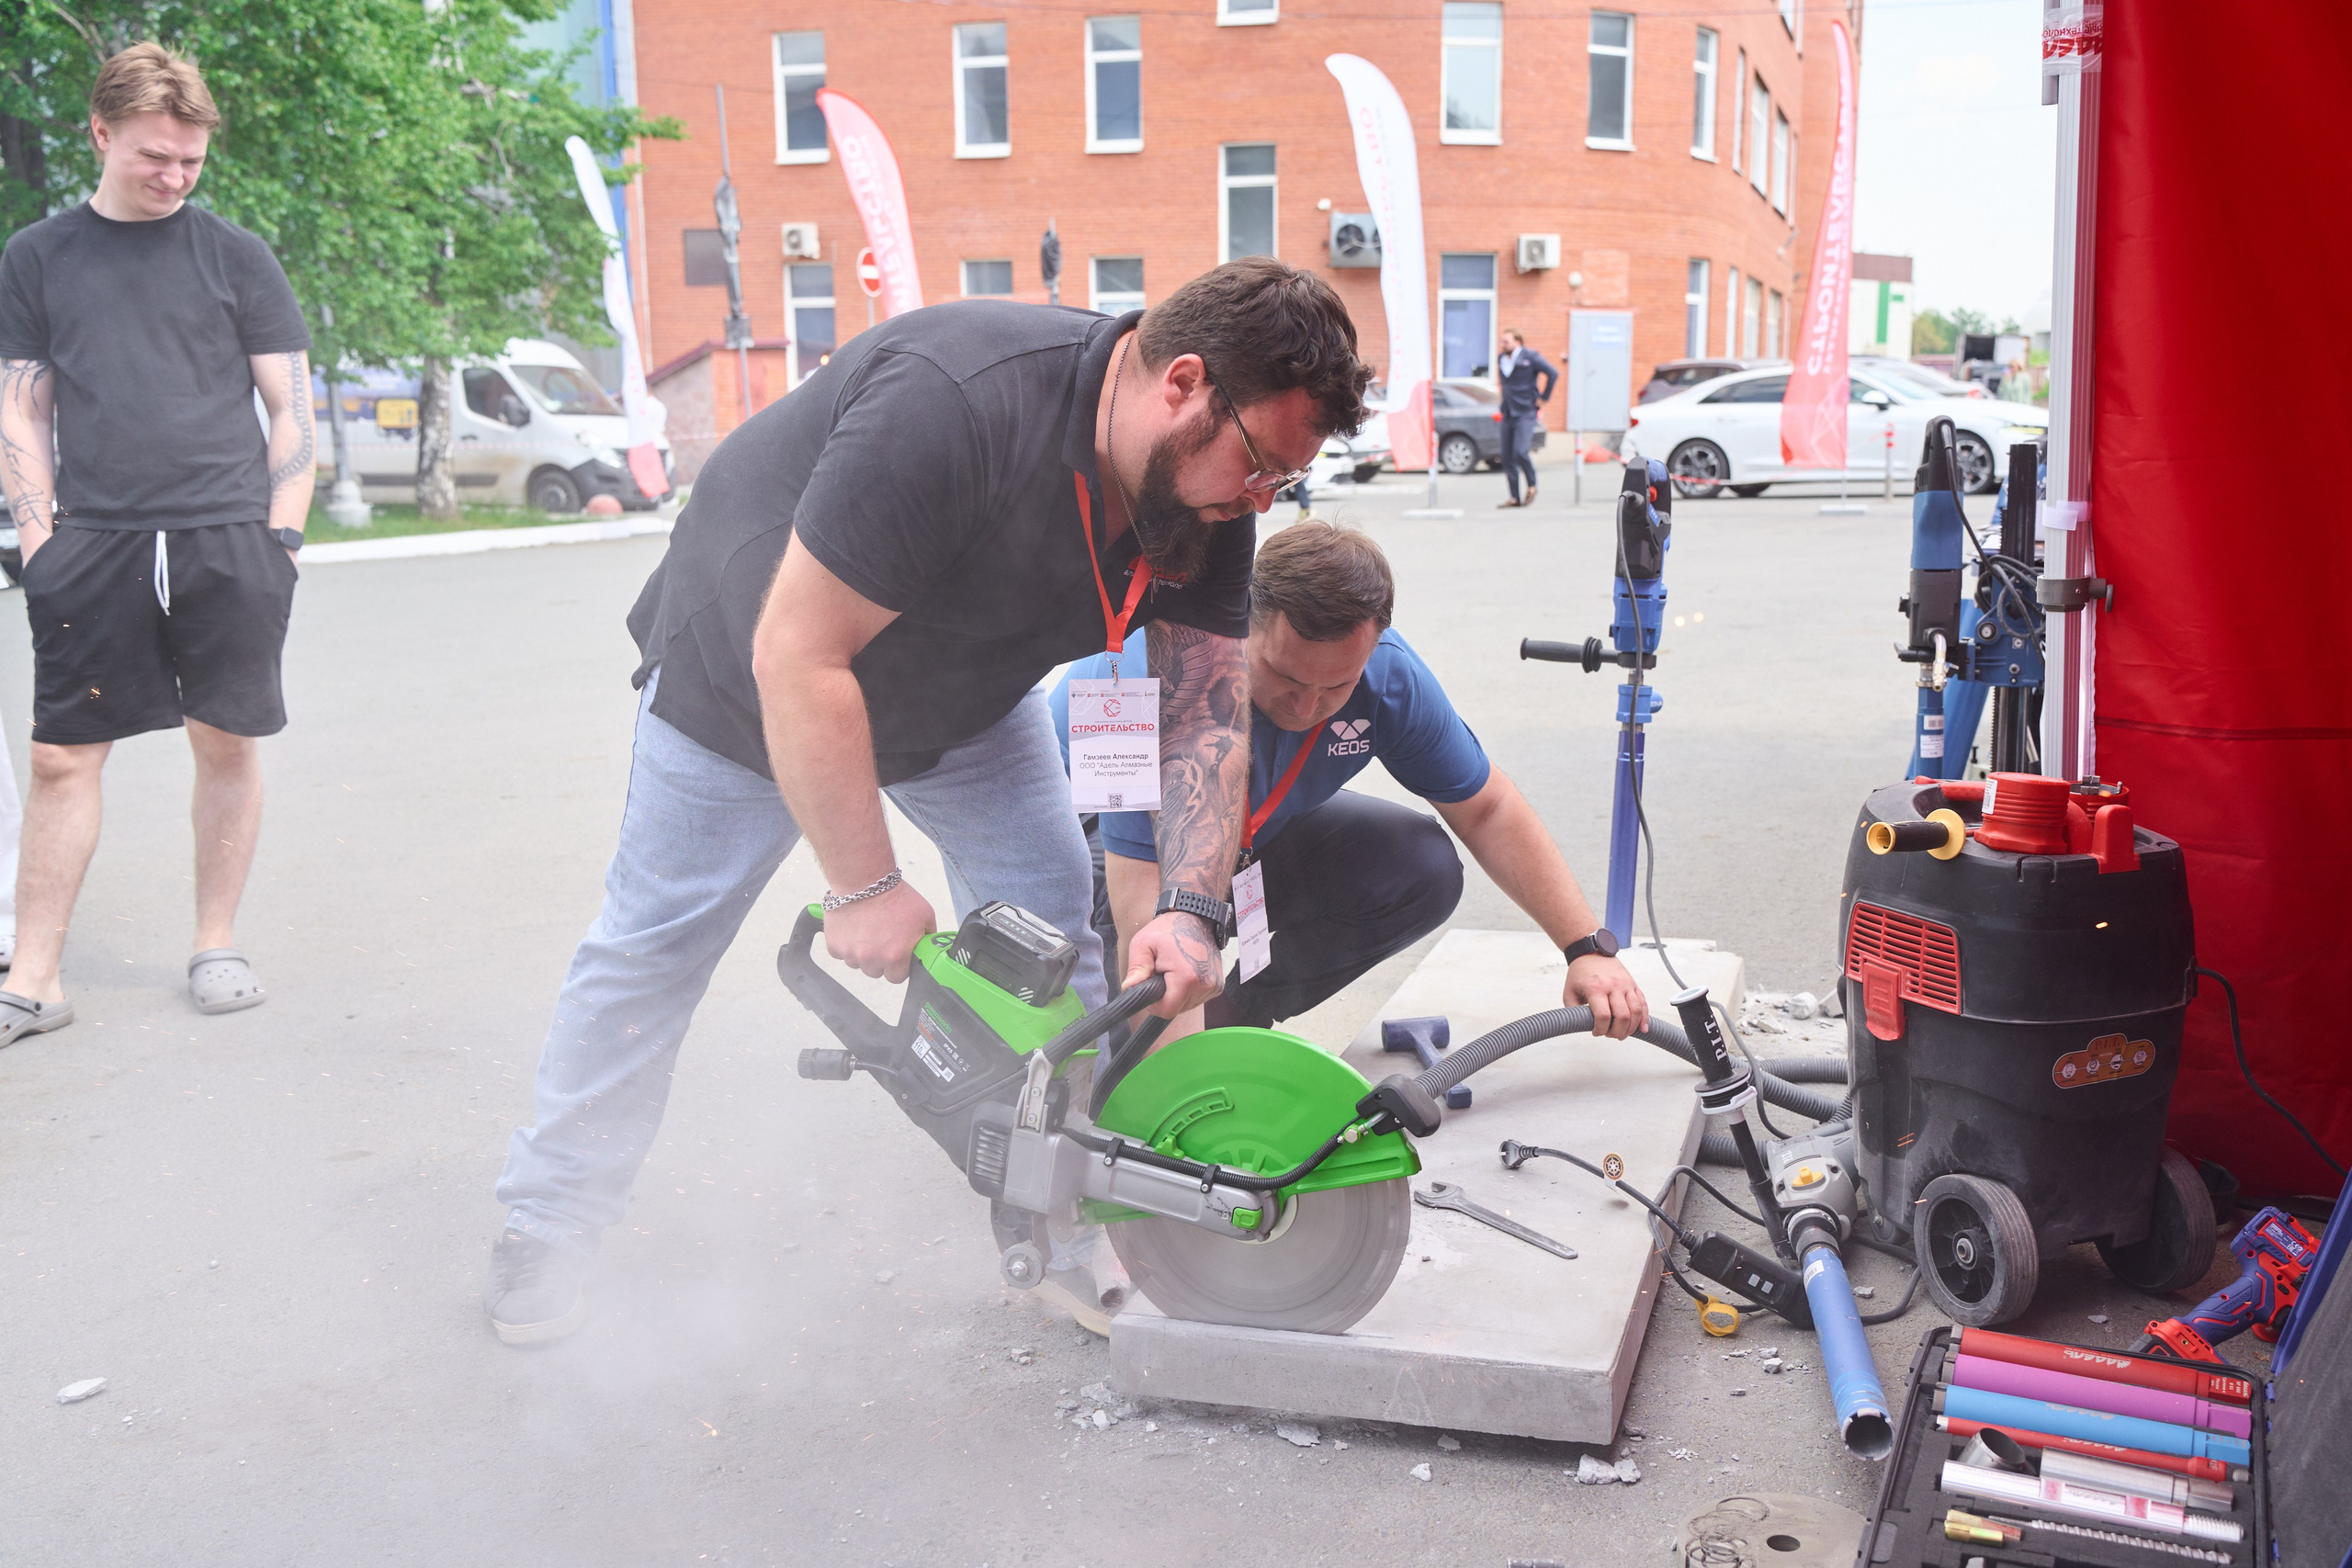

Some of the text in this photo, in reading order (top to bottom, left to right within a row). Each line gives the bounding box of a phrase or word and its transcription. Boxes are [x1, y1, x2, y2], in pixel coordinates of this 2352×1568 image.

[1071, 723, 1155, 733] СТРОИТЕЛЬСТВО
[1327, 739, 1370, 757] KEOS
[1079, 761, 1096, 770] ООО
[924, 1001, 953, 1033] greenworks
[913, 1042, 923, 1054] 110
